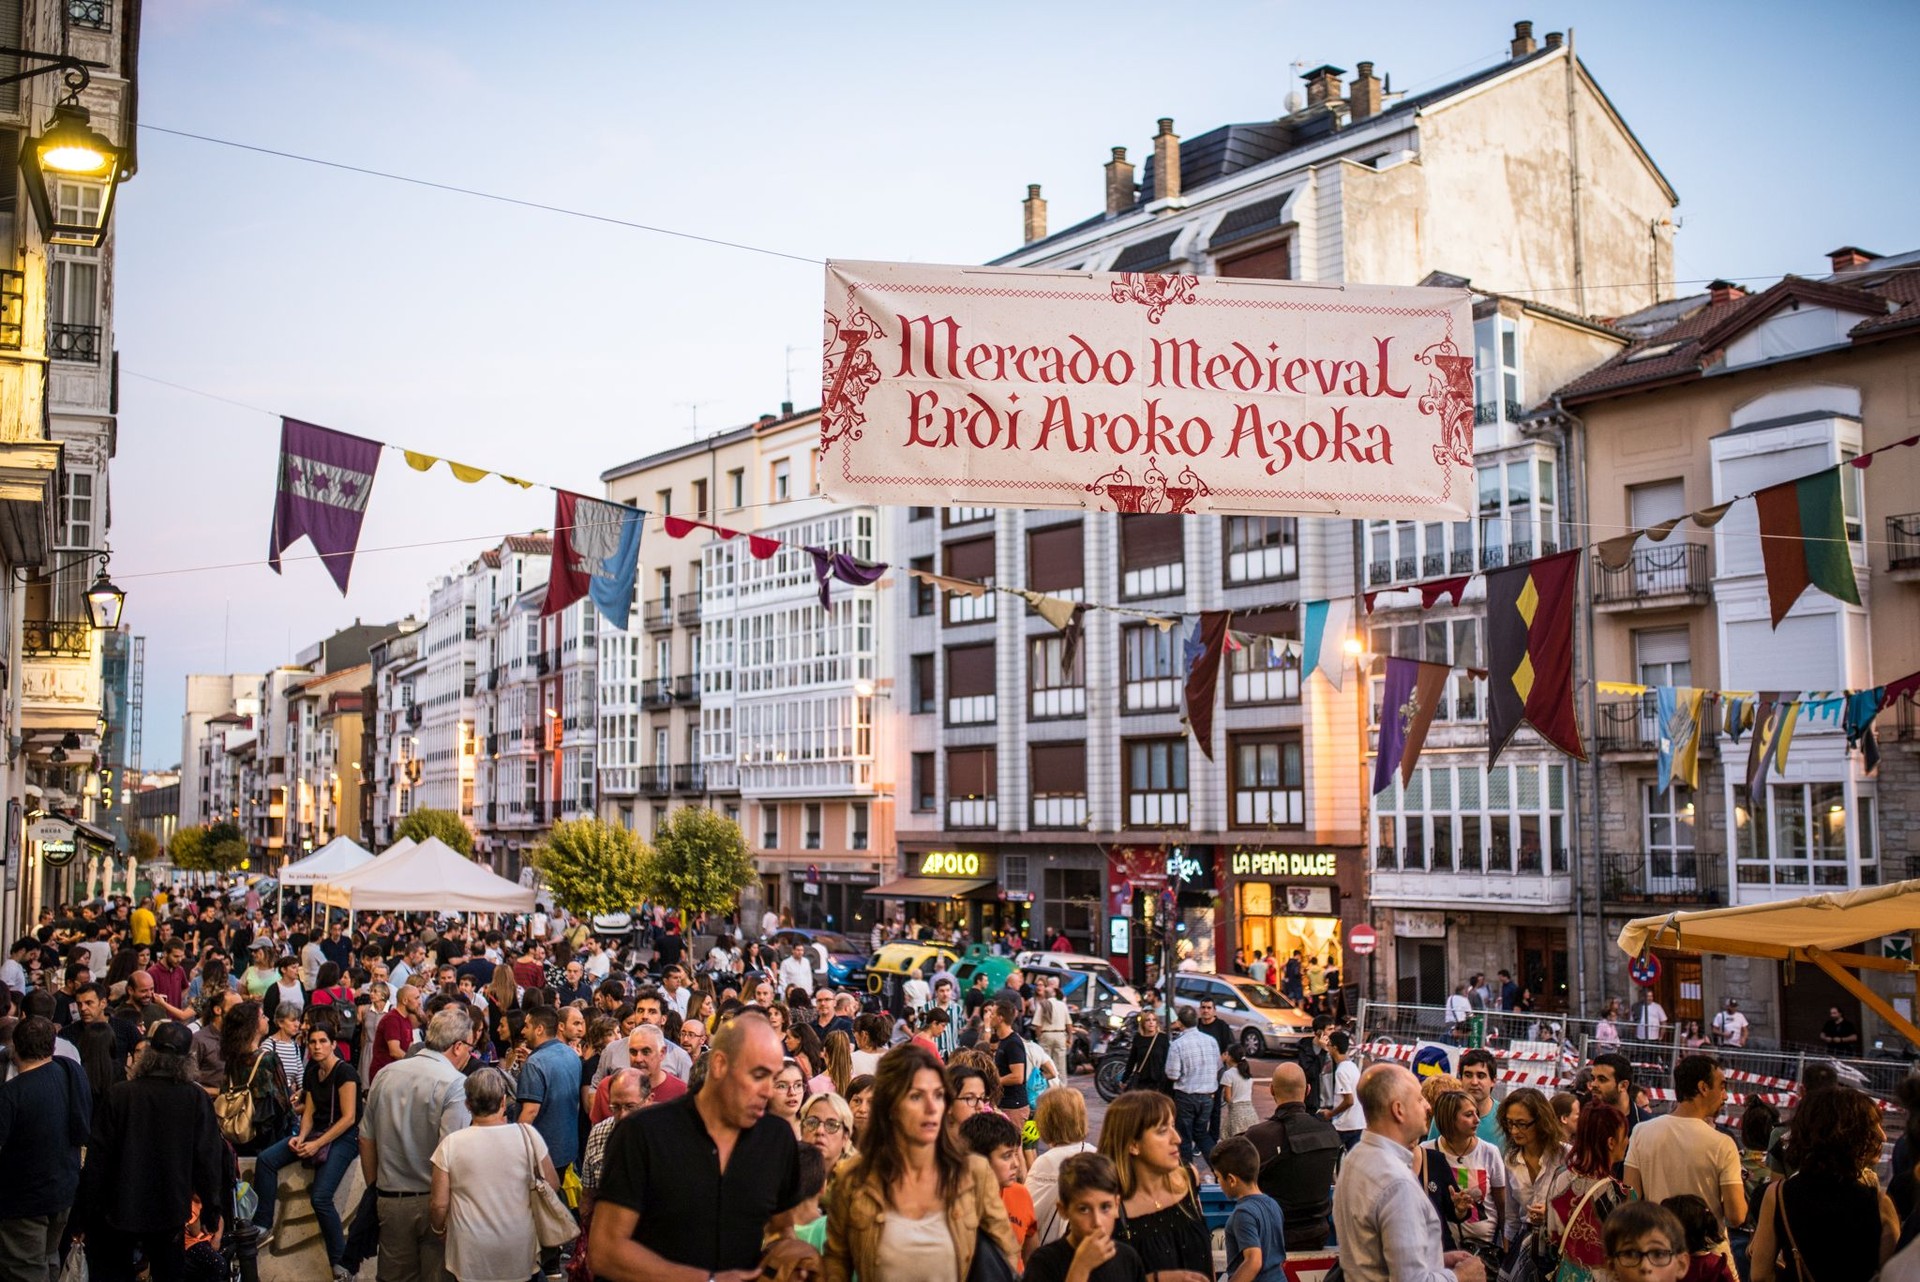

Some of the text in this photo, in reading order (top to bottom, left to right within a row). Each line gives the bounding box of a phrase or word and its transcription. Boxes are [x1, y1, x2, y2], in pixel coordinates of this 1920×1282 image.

[893, 313, 1135, 387] Mercado
[903, 390, 1394, 476] Erdi Aroko Azoka
[43, 843, 74, 852] GUINNESS
[921, 853, 979, 875] APOLO
[1232, 851, 1336, 876] LA PEÑA DULCE
